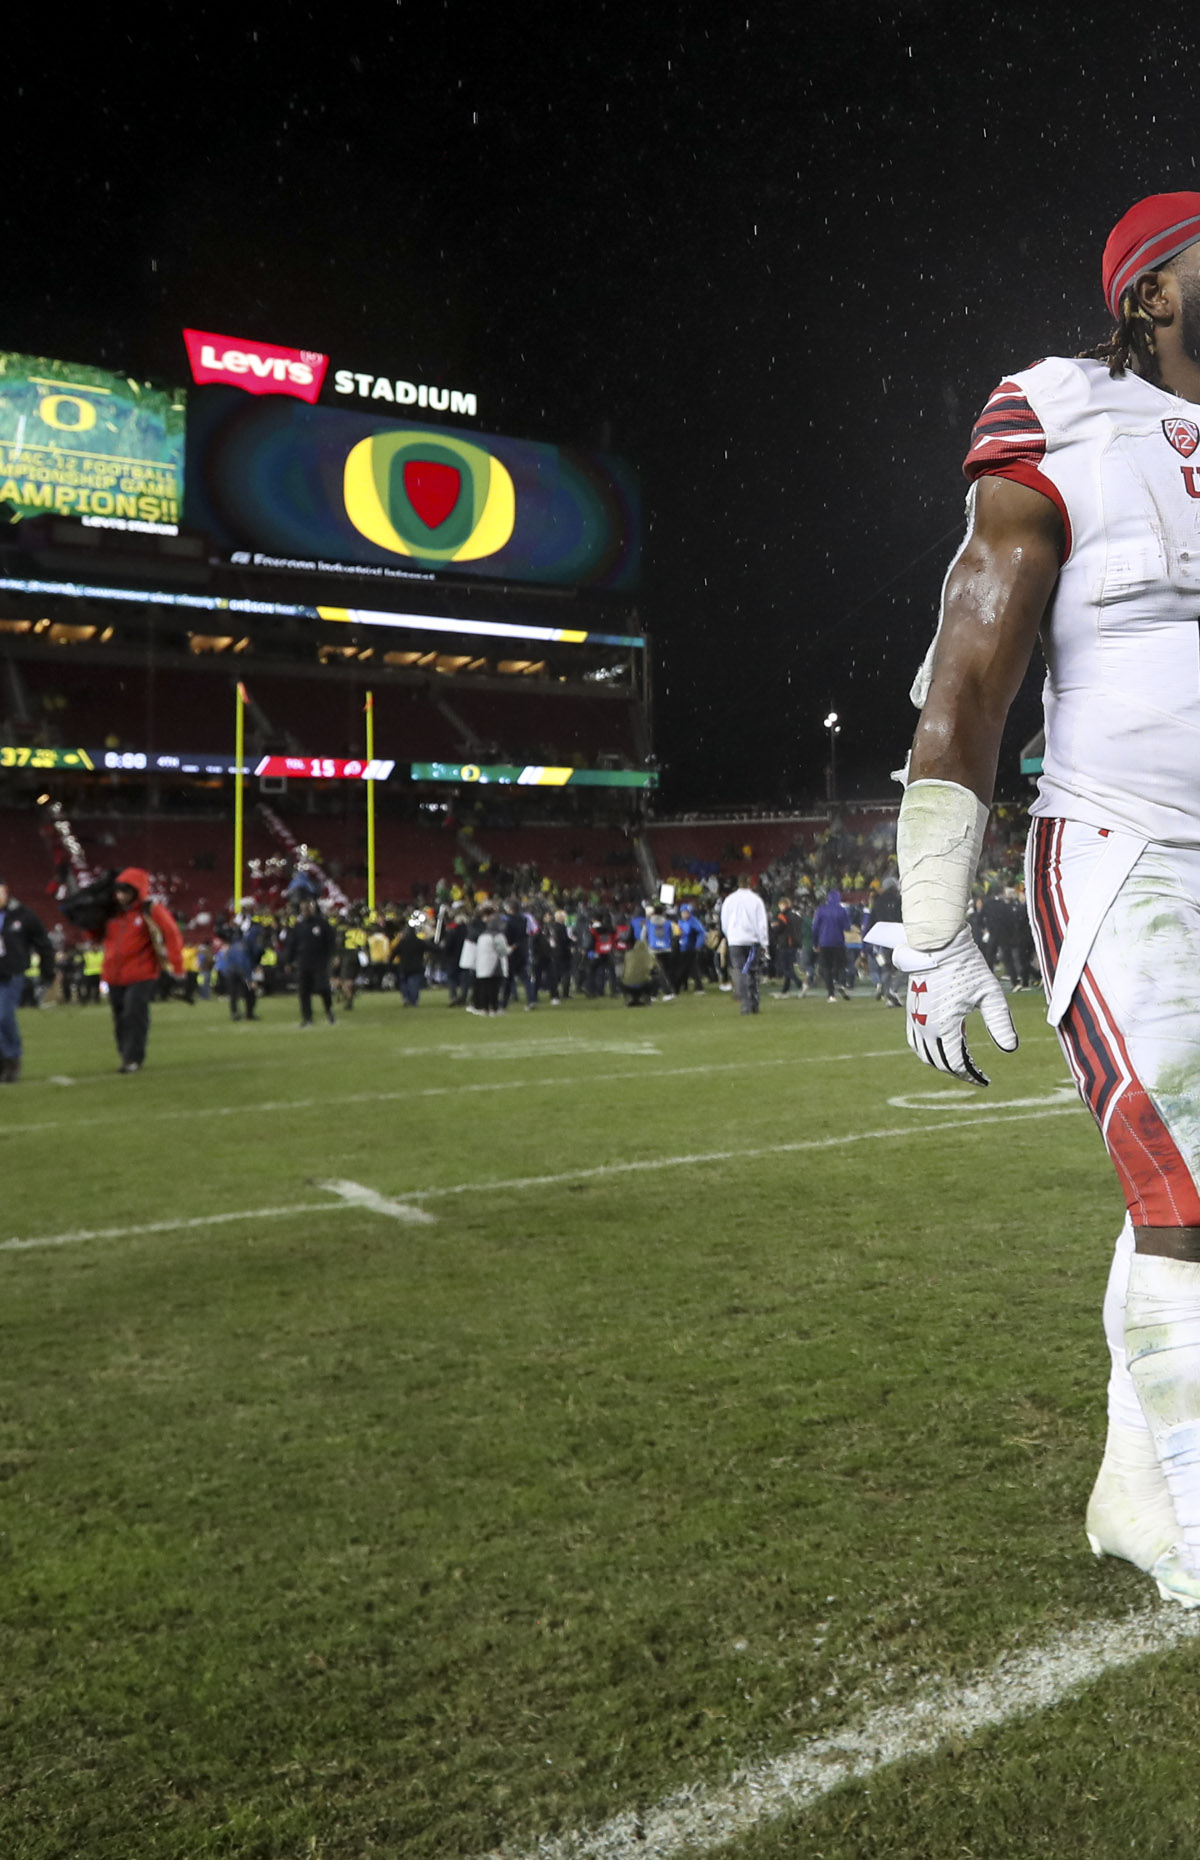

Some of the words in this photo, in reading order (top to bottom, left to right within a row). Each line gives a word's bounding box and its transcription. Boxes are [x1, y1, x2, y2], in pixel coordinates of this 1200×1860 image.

[334, 369, 477, 416] STADIUM
[1173, 434, 1194, 450] 12
[83, 459, 174, 480] FOOTBALL
[120, 477, 177, 498] GAME
[0, 746, 31, 767] 37
[310, 759, 335, 777] 15
